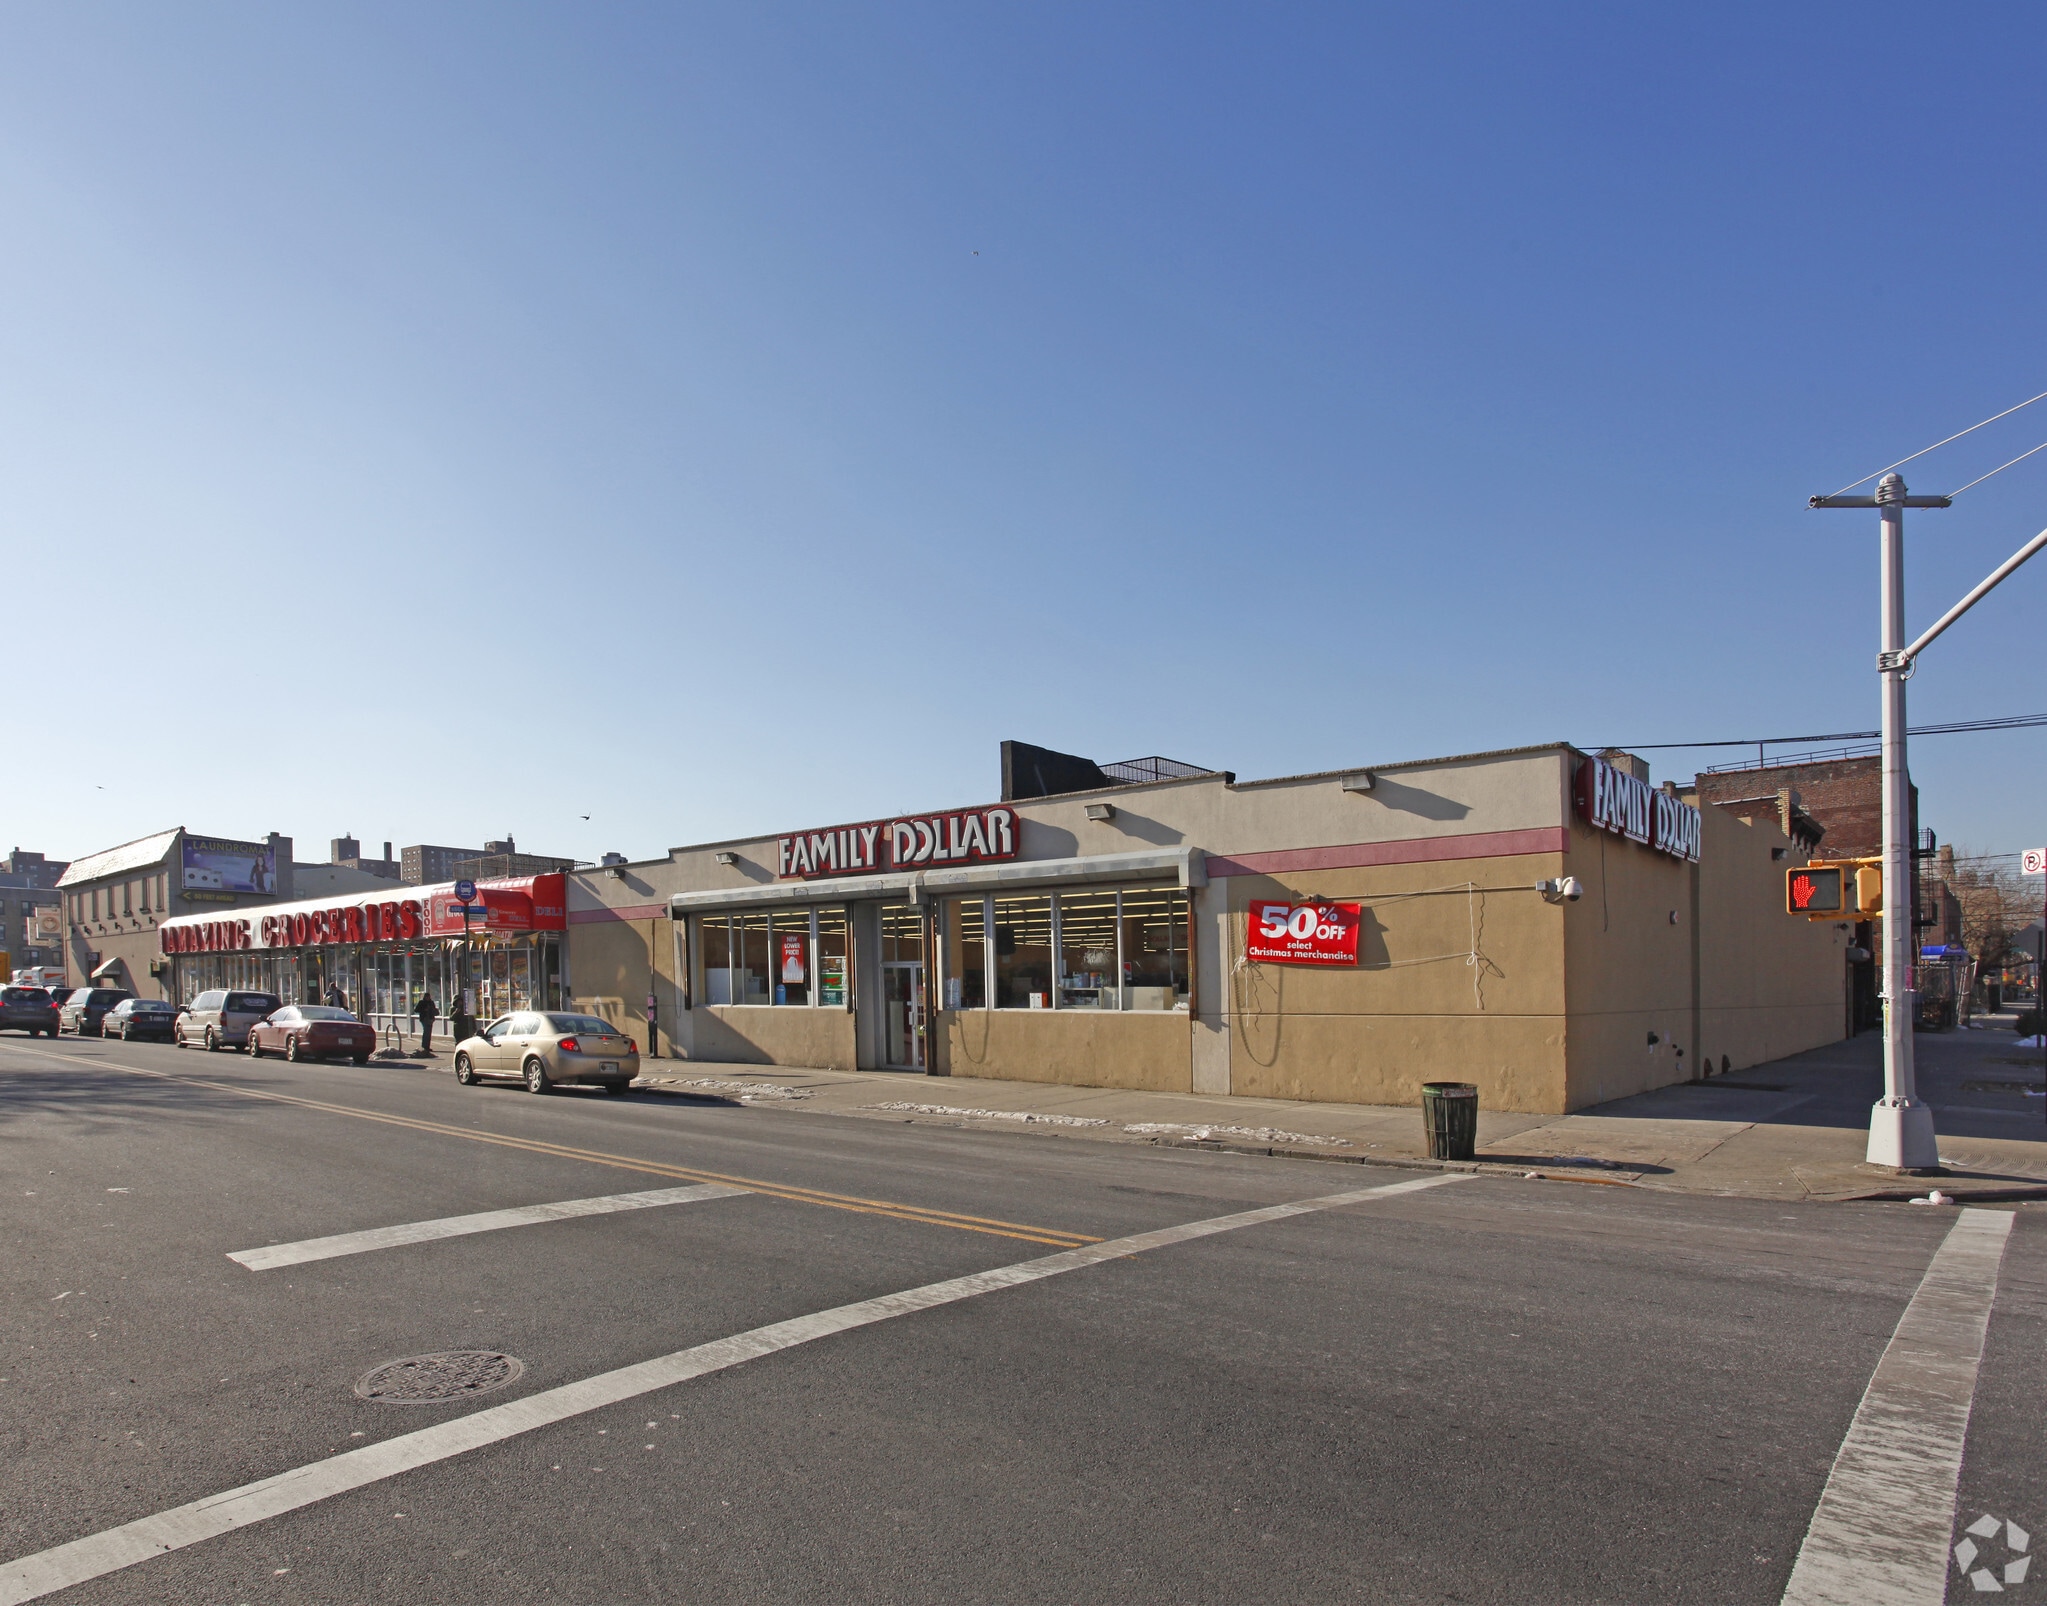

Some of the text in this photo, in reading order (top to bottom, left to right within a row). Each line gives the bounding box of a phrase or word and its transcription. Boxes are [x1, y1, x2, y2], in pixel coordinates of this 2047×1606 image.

[1593, 760, 1701, 860] FAMILY DOLLAR
[192, 840, 271, 855] LAUNDROMAT
[778, 809, 1013, 876] FAMILY DOLLAR
[423, 900, 431, 936] FOOD
[535, 906, 563, 917] DELI
[161, 899, 421, 952] AMAZING GROCERIES
[1316, 924, 1347, 940] OFF
[1287, 940, 1313, 950] select
[1249, 946, 1354, 961] Christmas merchandise
